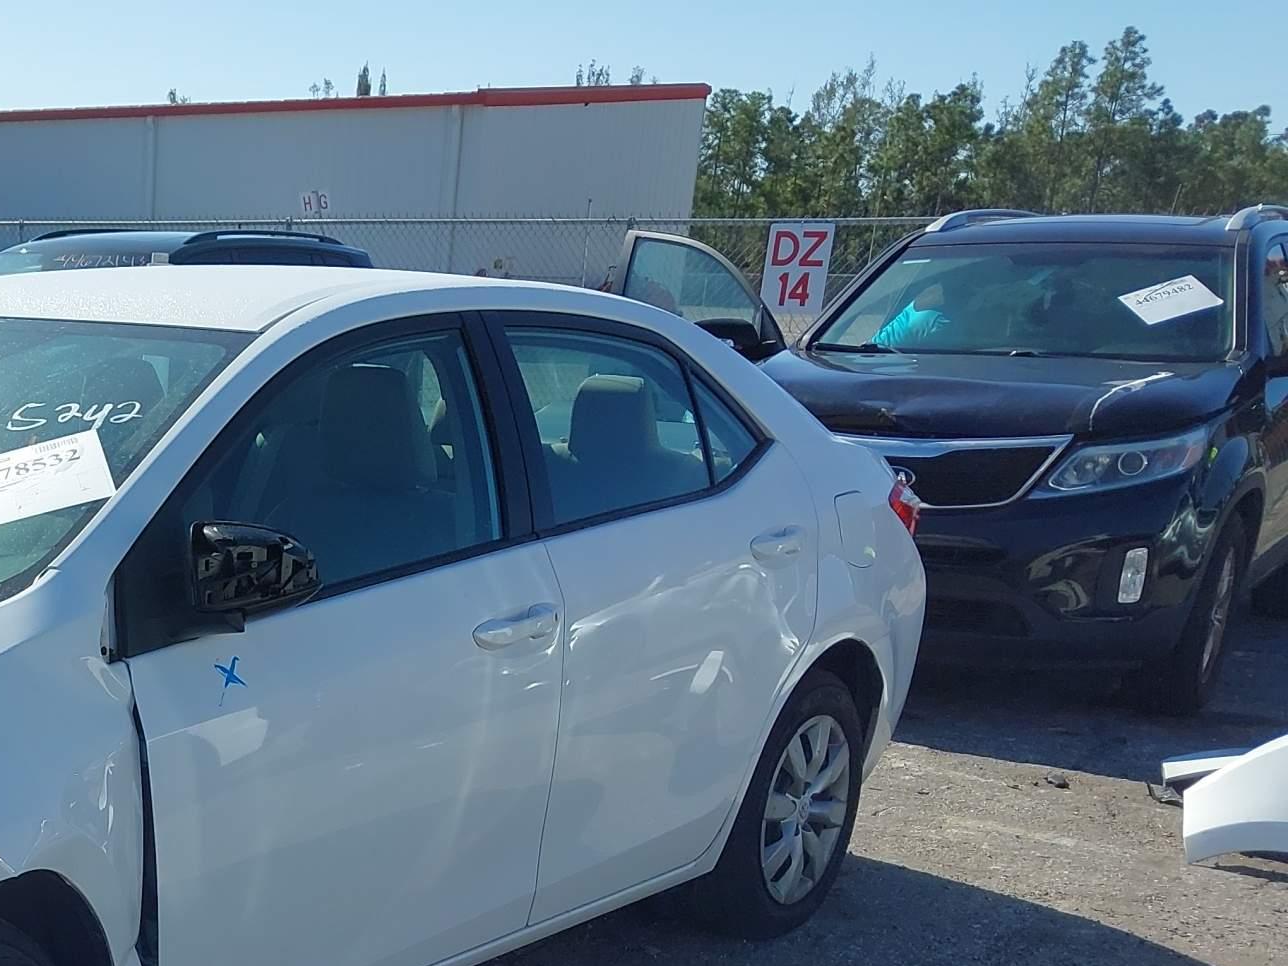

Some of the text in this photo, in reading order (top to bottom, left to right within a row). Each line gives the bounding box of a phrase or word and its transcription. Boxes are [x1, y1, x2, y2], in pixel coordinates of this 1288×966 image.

[771, 230, 828, 267] DZ
[778, 271, 810, 307] 14
[1134, 283, 1194, 306] 44679482
[6, 401, 143, 431] 5242
